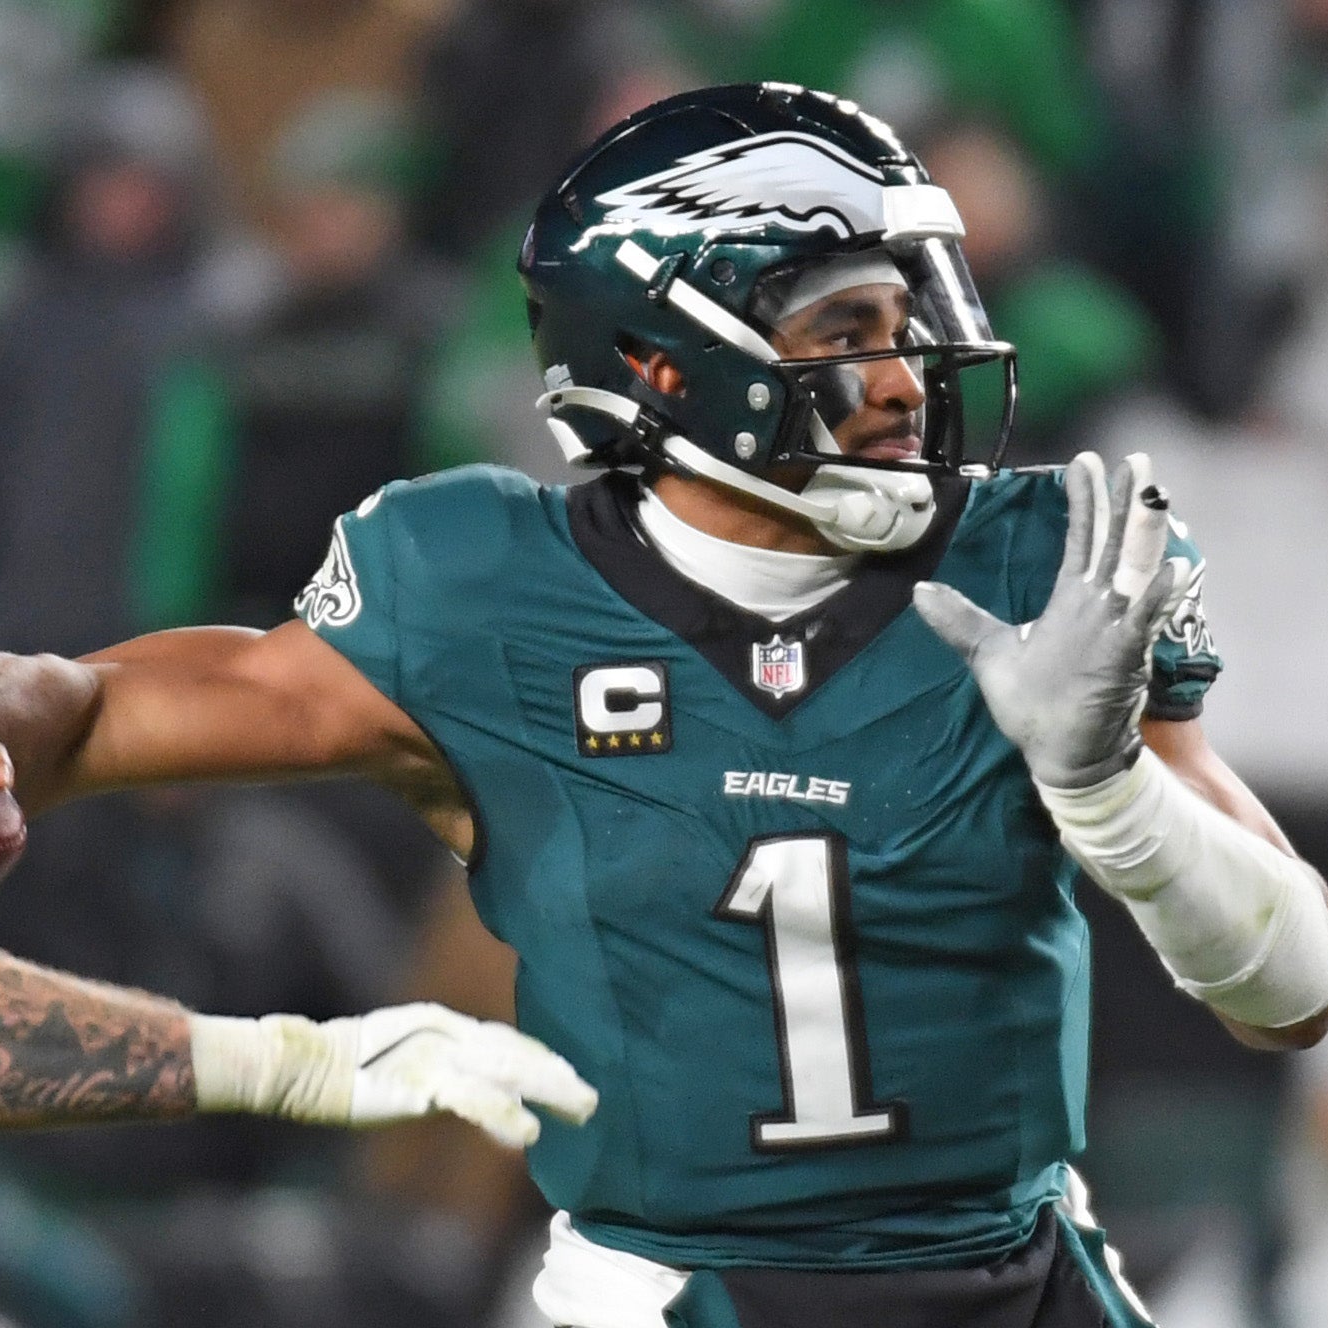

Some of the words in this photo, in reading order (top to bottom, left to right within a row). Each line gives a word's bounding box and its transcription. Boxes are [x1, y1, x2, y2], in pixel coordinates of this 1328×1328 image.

[580, 667, 663, 732] C
[763, 664, 793, 686] NFL
[724, 771, 851, 805] EAGLES
[721, 834, 899, 1147] 1
